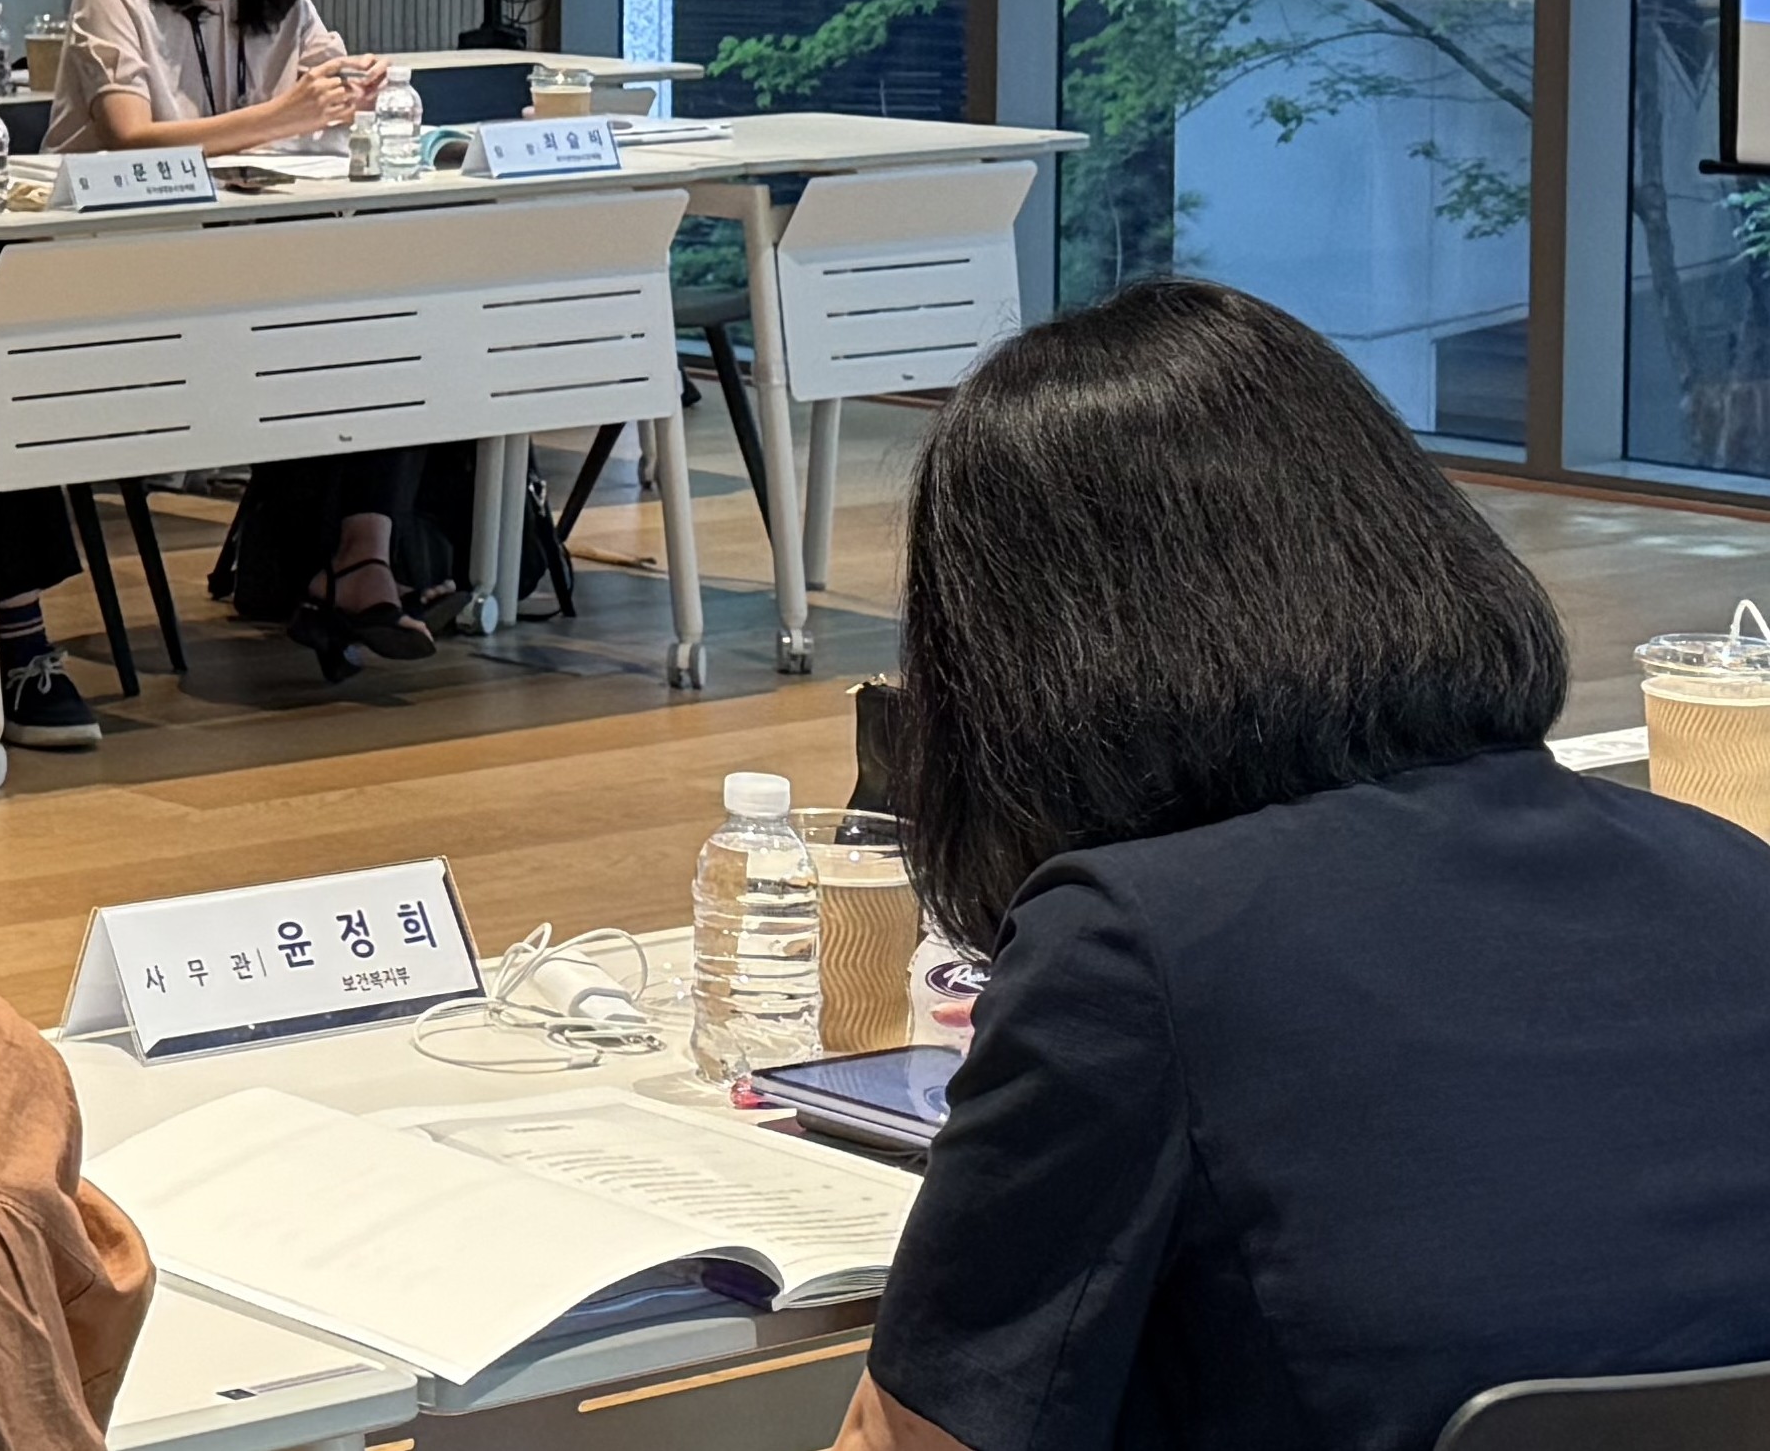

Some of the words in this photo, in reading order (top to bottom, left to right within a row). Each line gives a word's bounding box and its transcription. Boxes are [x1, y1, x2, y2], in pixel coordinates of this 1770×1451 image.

[146, 951, 254, 993] 사무관
[277, 900, 438, 969] 윤정희
[343, 966, 410, 993] 보건복지부
